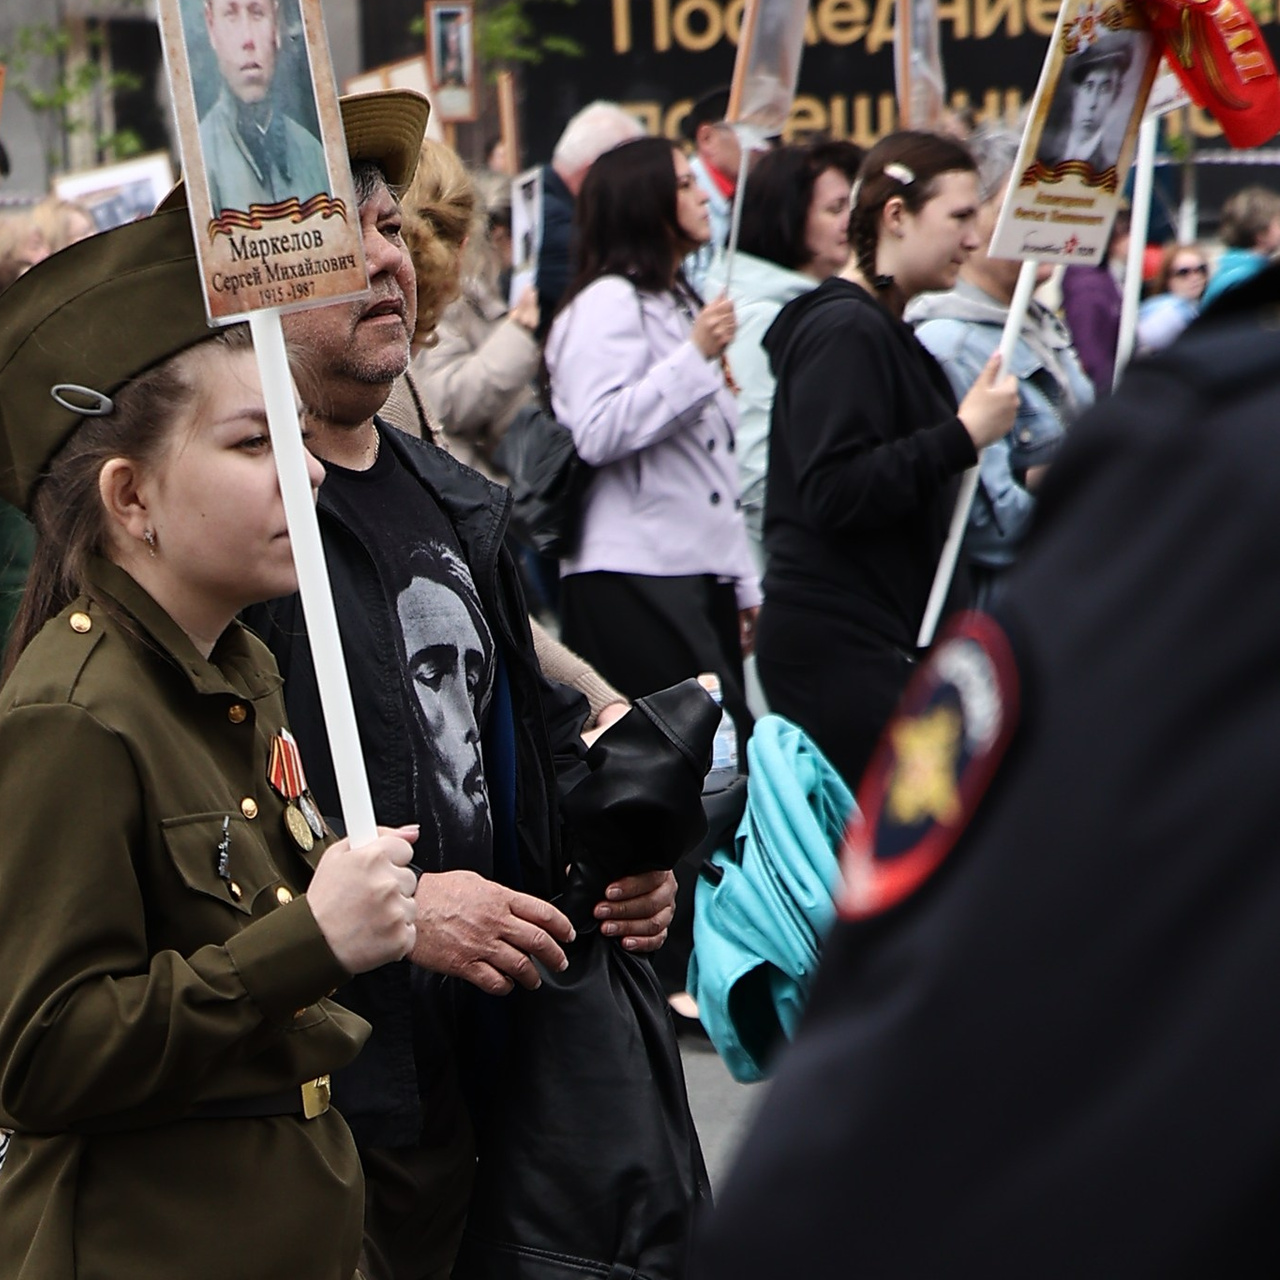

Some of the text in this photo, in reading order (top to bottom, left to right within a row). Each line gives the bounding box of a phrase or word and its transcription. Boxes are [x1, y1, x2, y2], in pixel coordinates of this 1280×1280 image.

[228, 229, 324, 264] Маркелов
[212, 255, 356, 295] Сергей Михайлович
[259, 287, 283, 305] 1915
